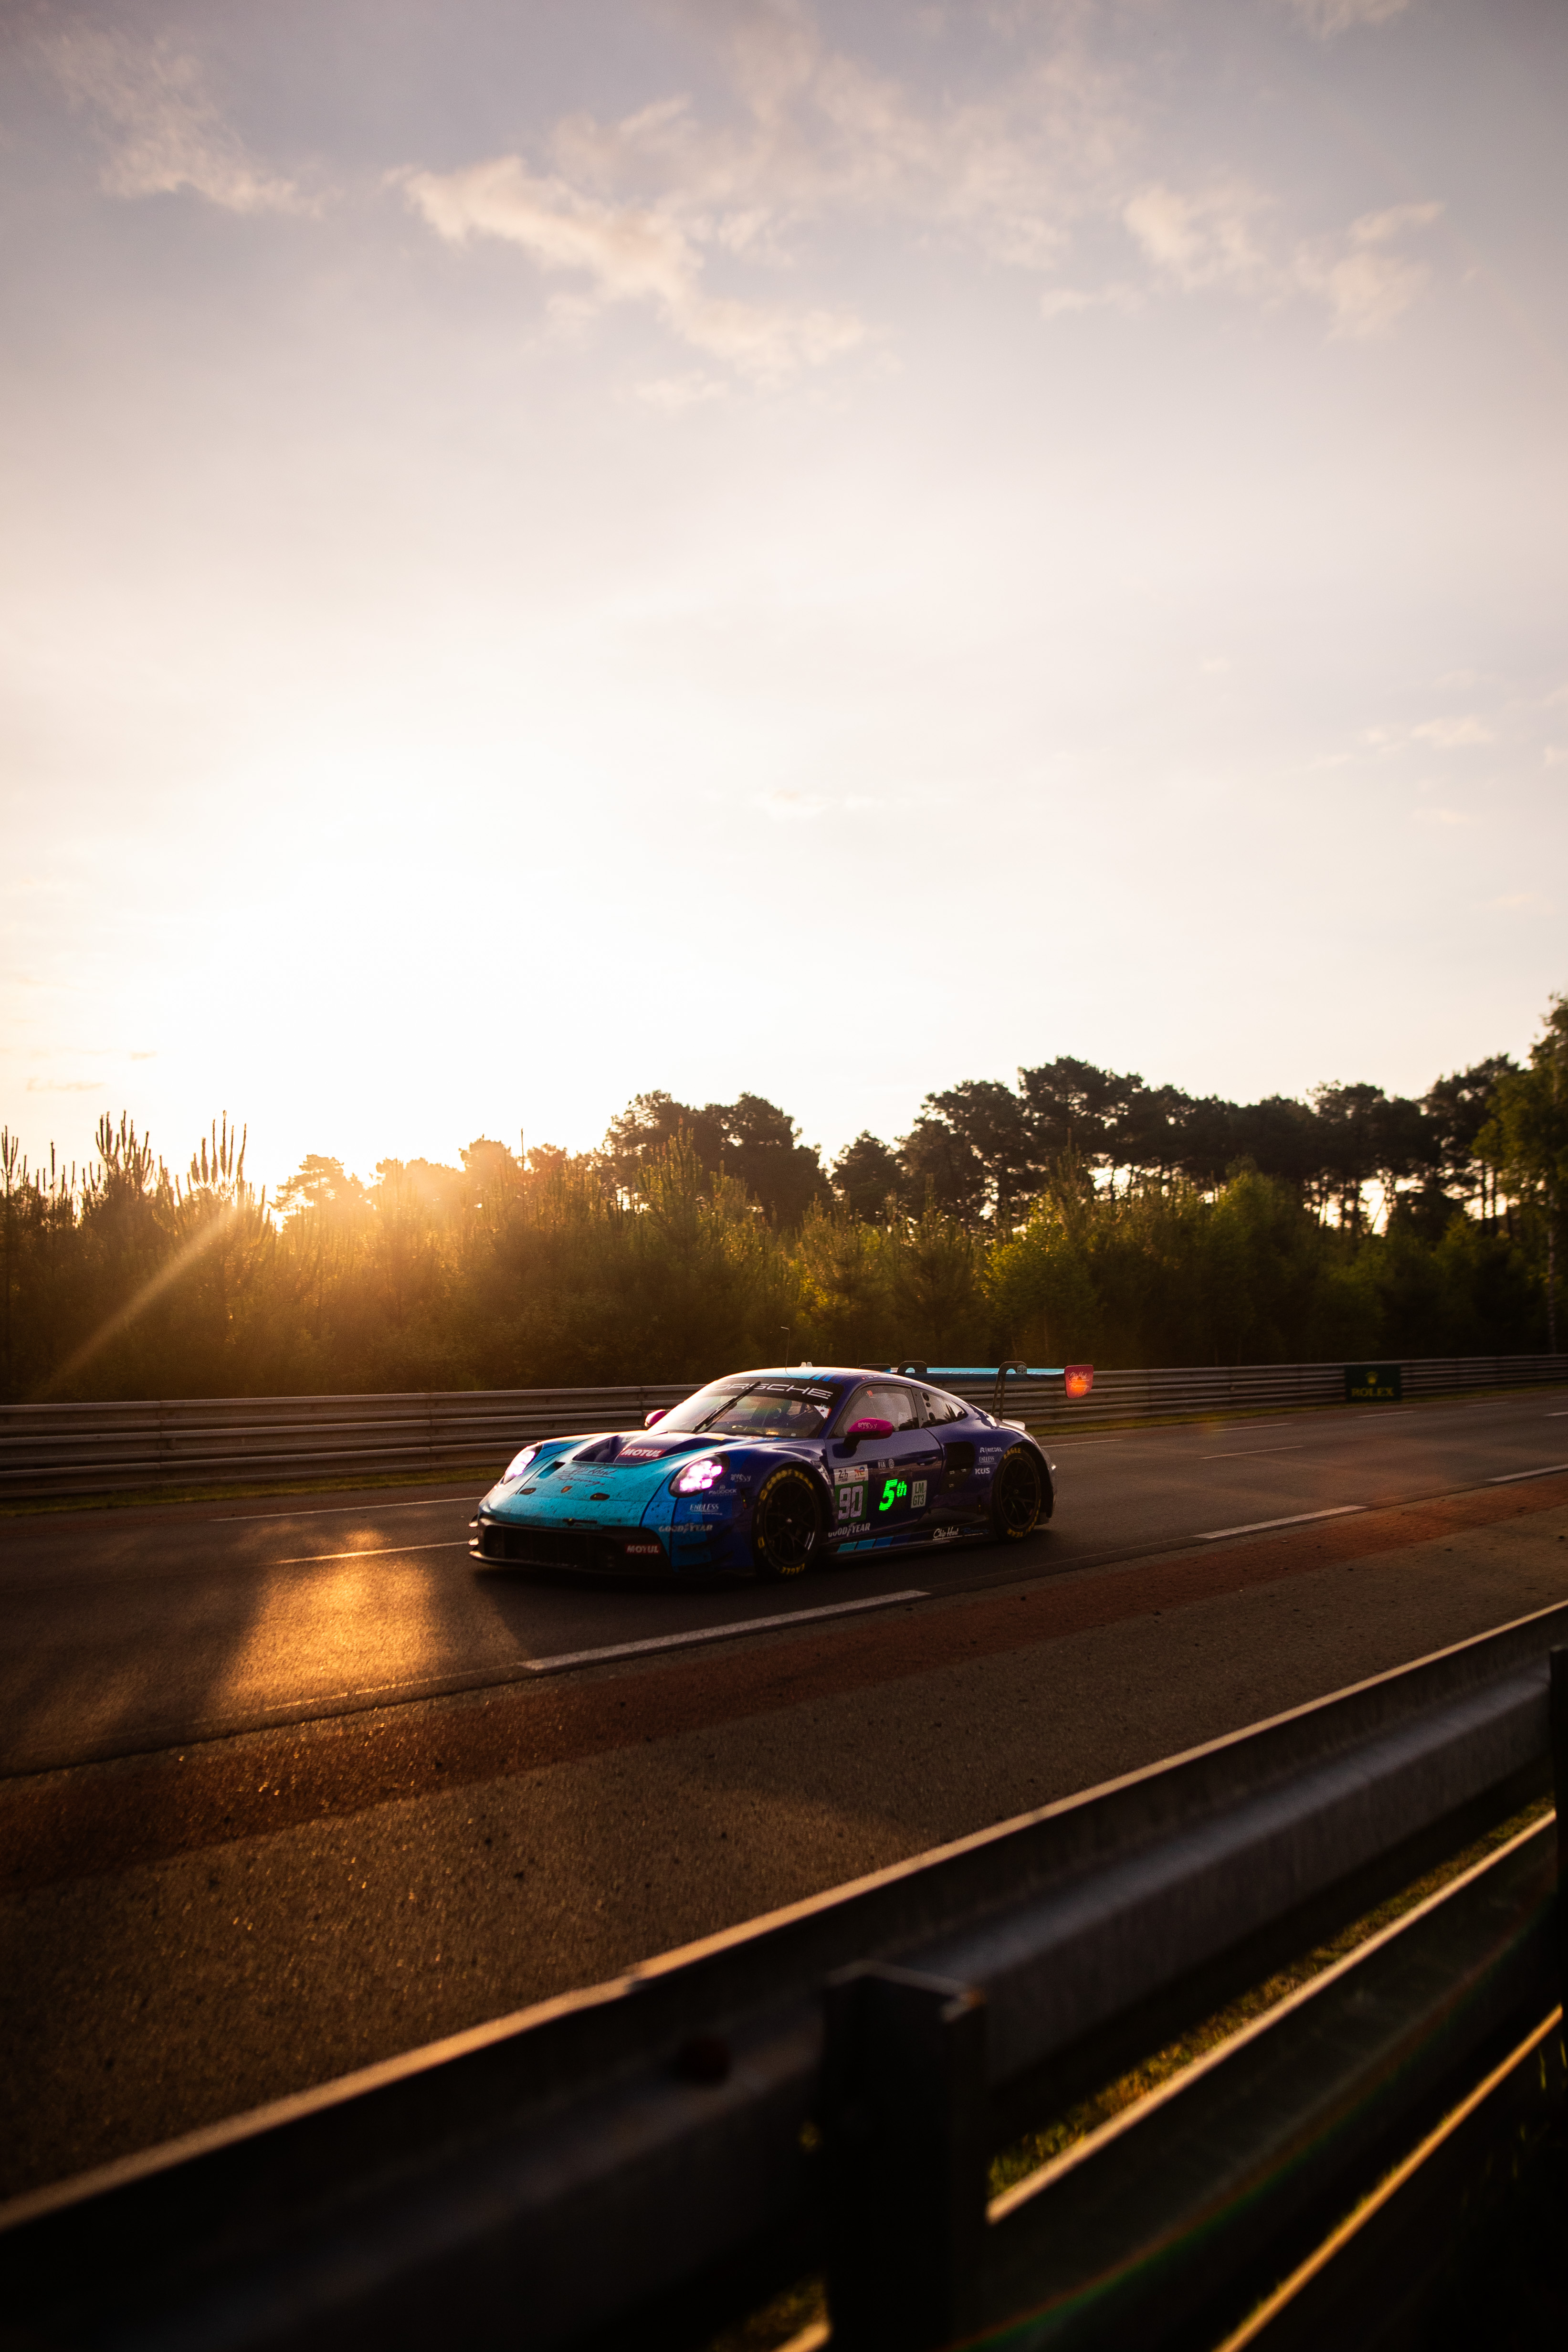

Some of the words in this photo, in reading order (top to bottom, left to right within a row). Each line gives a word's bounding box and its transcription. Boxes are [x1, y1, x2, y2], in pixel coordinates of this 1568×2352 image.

[1351, 1387, 1394, 1397] ROLEX
[621, 1448, 662, 1457] MOTUL
[915, 1482, 924, 1494] LM
[879, 1479, 907, 1511] 5th
[838, 1486, 863, 1520] 90
[913, 1495, 925, 1507] GT3
[690, 1504, 719, 1512] ENDLESS
[933, 1528, 945, 1539] Chip
[626, 1545, 659, 1553] MOTUL
